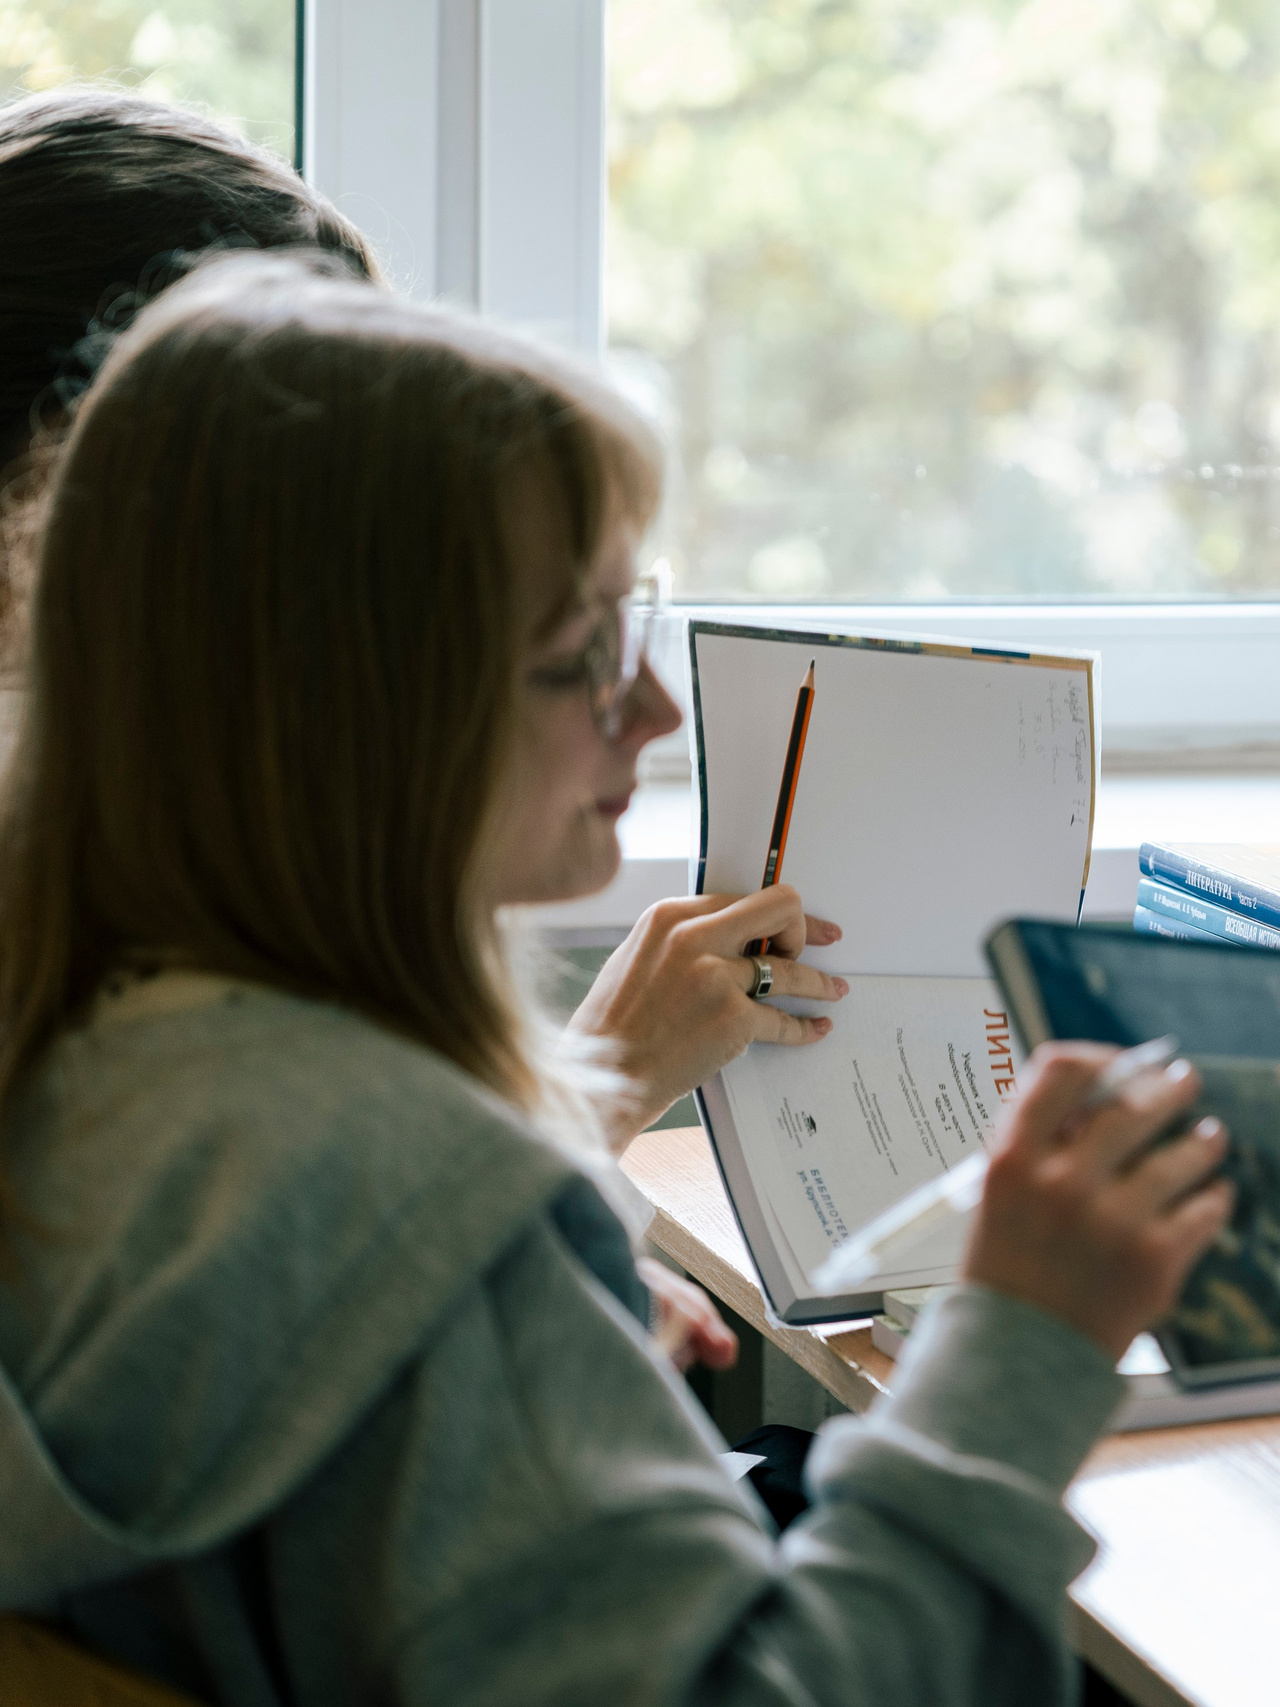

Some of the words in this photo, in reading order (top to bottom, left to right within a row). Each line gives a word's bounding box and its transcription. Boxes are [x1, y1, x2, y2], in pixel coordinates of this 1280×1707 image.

[1184, 869, 1235, 900] ЛИТЕРАТУРА
[1236, 891, 1253, 908] Часть
[1250, 897, 1259, 909] 2
[1223, 916, 1259, 943] ВСЕОБЩАЯ
[983, 1009, 1020, 1104] ЛИТЕ
[937, 1082, 946, 1091] В
[940, 1092, 955, 1113] двух
[960, 1050, 981, 1099] Учебник
[974, 1100, 989, 1120] для
[932, 1096, 948, 1123] Часть
[943, 1124, 952, 1132] 1
[950, 1114, 967, 1144] частях
[810, 1168, 849, 1239] БИБЛИОТЕК
